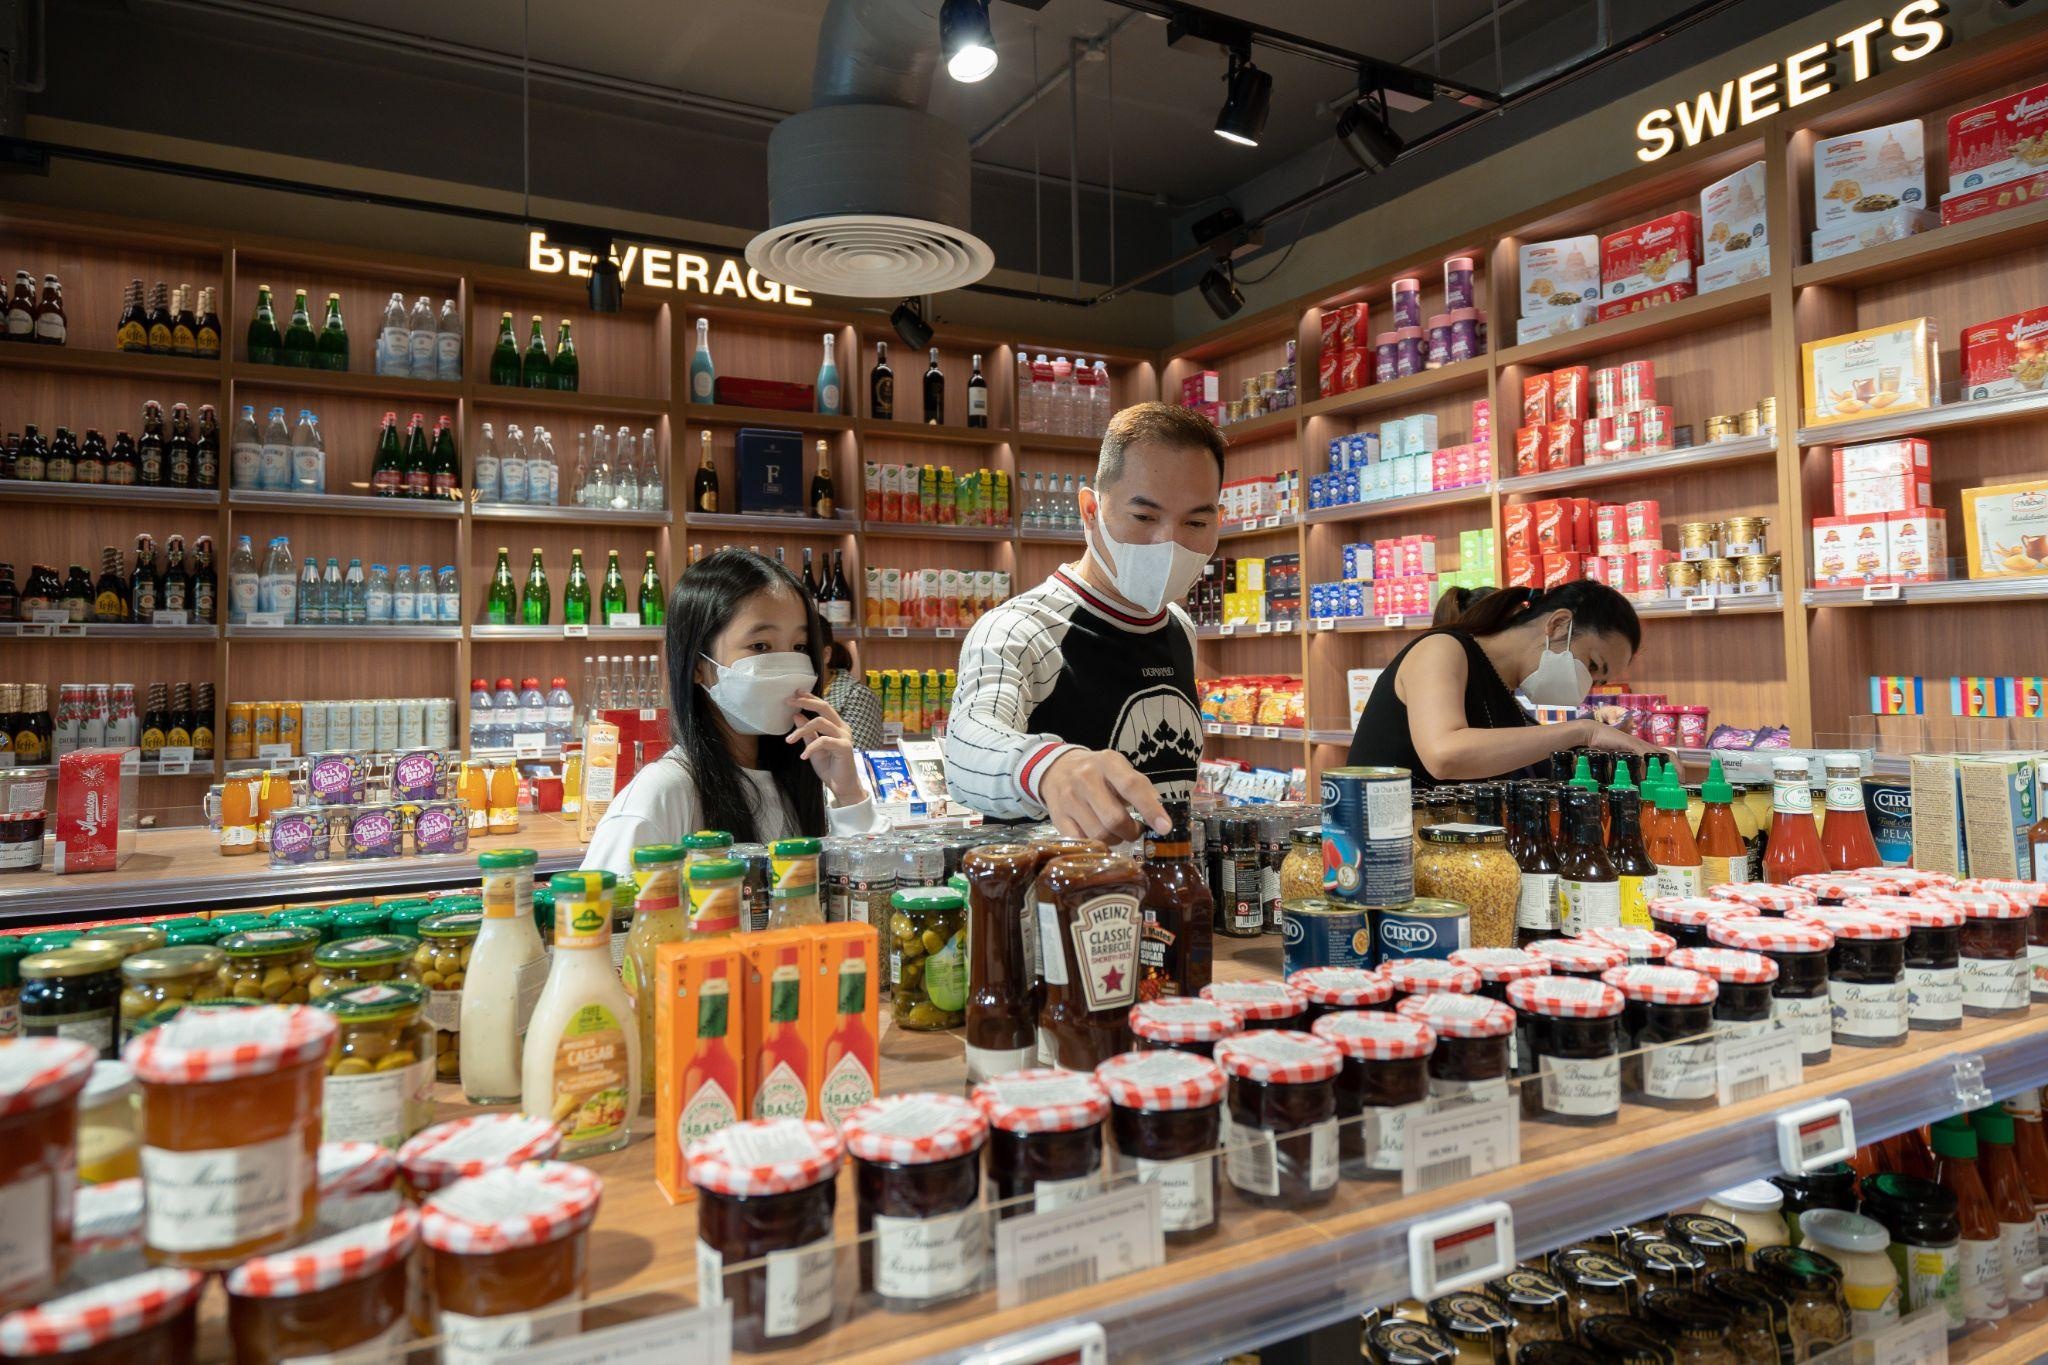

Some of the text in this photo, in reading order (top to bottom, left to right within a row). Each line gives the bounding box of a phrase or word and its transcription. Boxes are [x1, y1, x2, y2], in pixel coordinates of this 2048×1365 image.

[1636, 0, 1945, 162] SWEETS
[528, 232, 813, 307] BEVERAGE
[766, 465, 781, 484] F
[316, 767, 341, 780] JELLY
[401, 762, 427, 774] JELLY
[321, 774, 346, 788] BEAN
[406, 769, 430, 782] BEAN
[1878, 795, 1912, 807] CIRI
[356, 820, 382, 834] JELLY
[420, 817, 441, 830] JELLY
[277, 826, 300, 840] JELLY
[363, 827, 388, 841] BEAN
[424, 824, 448, 838] BEAN
[1883, 829, 1912, 839] PELA
[282, 833, 308, 846] BEAN
[1093, 906, 1129, 923] HEINZ
[1089, 927, 1132, 945] CLASSIC
[1149, 927, 1171, 941] Mates
[1383, 925, 1430, 942] CIRIO
[1091, 941, 1131, 956] BARBECUE
[568, 1045, 614, 1067] CAESAR
[755, 1100, 805, 1117] TABASC
